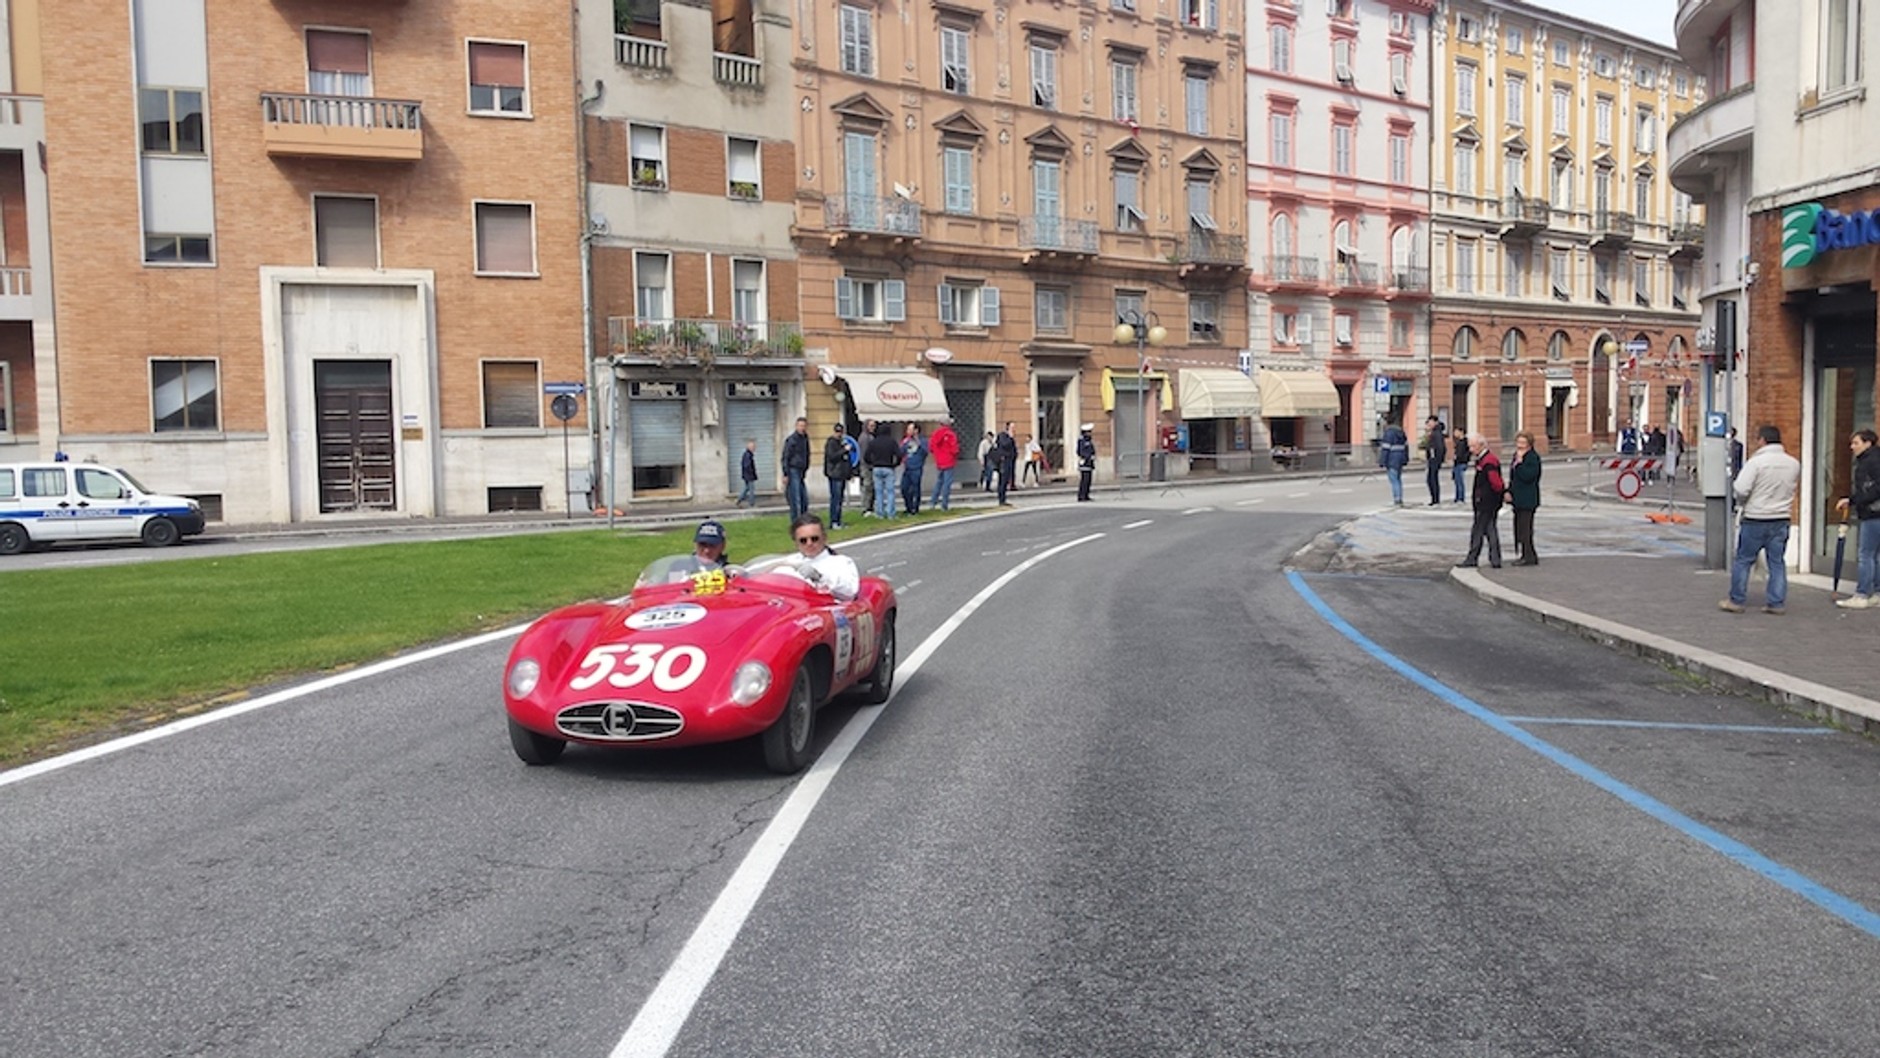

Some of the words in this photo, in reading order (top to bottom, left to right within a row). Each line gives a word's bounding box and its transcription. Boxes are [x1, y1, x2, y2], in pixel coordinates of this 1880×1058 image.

[1377, 378, 1388, 391] P
[1708, 415, 1723, 432] P
[691, 569, 726, 588] 325
[643, 610, 686, 622] 325
[569, 643, 707, 692] 530
[610, 703, 628, 736] E
